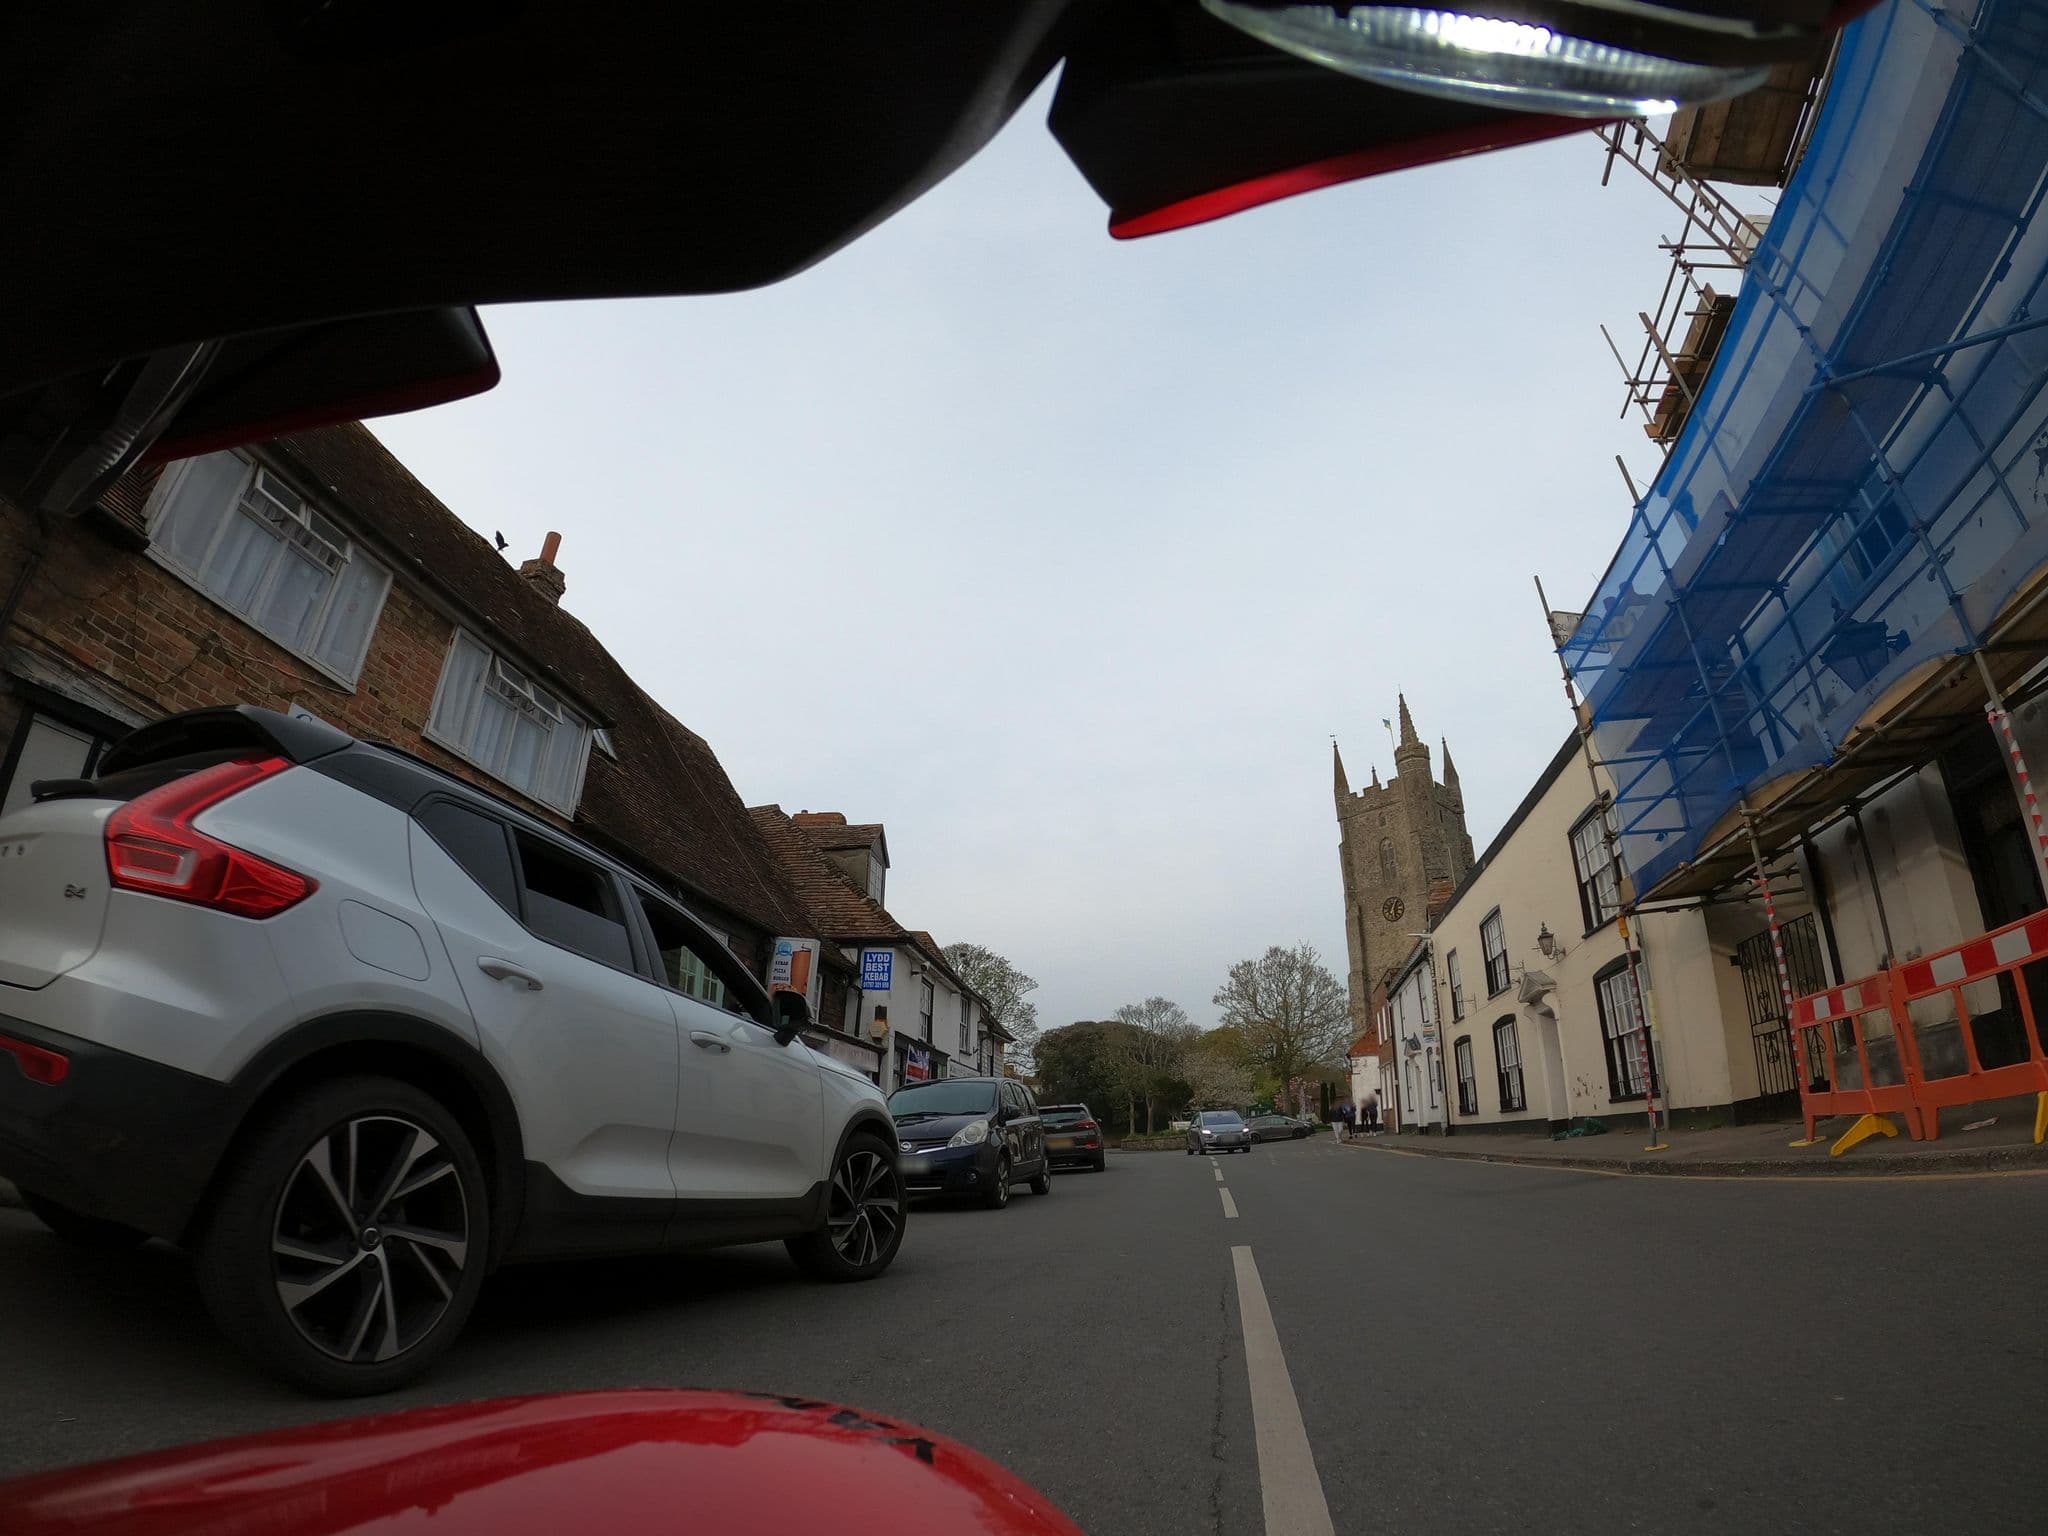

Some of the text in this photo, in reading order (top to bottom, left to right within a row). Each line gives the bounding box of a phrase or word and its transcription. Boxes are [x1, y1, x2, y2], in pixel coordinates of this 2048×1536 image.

[866, 953, 890, 963] LYDD
[865, 962, 890, 972] BEST
[864, 972, 889, 981] KEBAB
